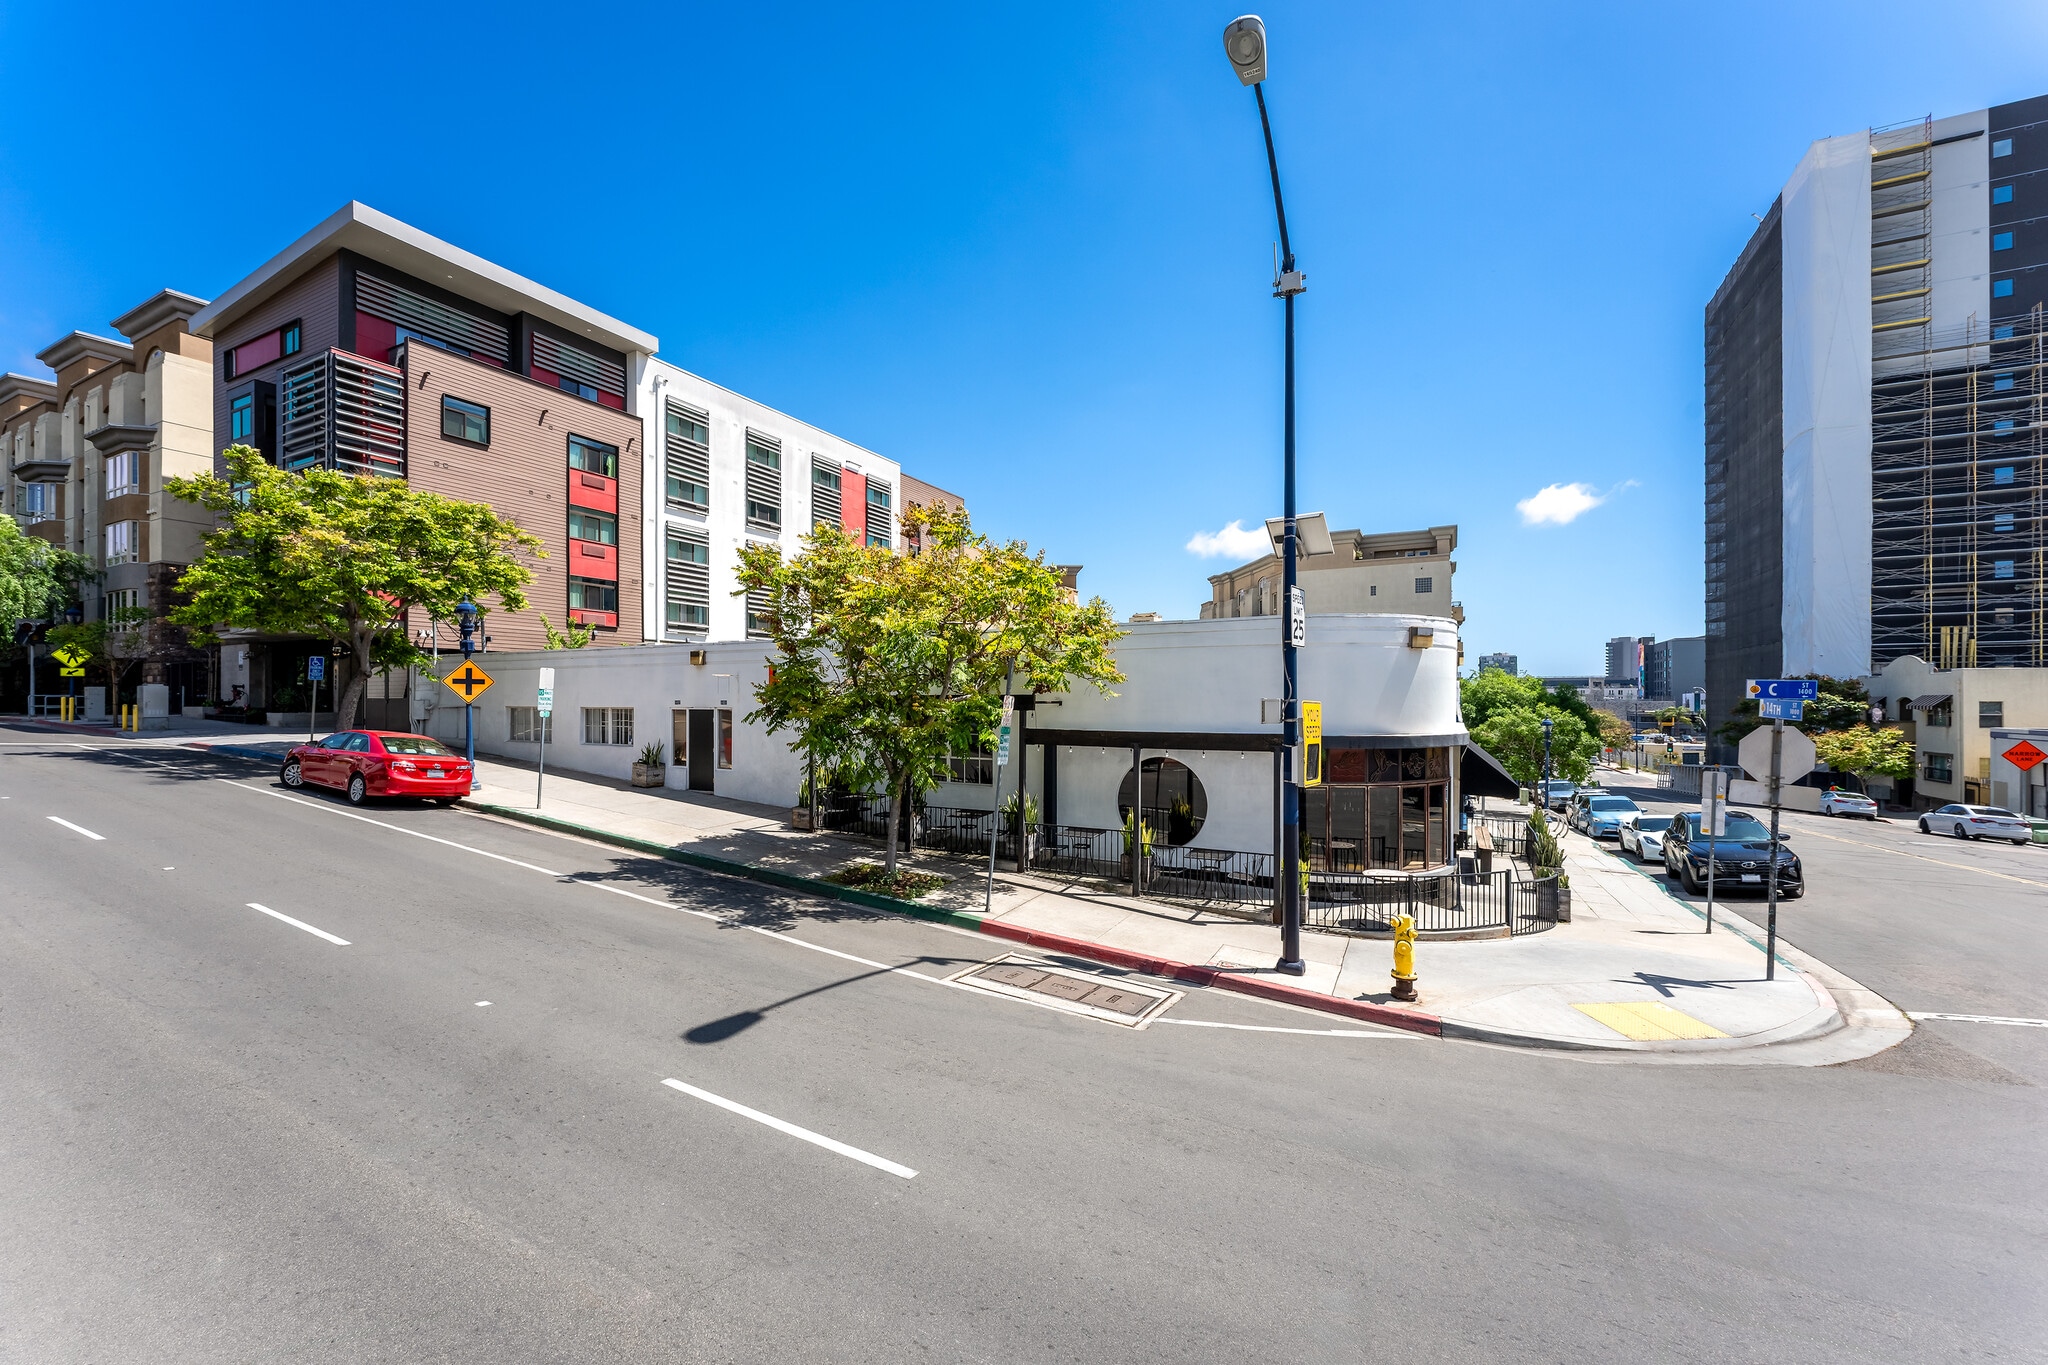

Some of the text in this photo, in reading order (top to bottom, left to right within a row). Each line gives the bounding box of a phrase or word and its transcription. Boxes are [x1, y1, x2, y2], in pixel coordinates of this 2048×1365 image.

[1292, 593, 1304, 605] SPEED
[1293, 605, 1303, 616] LIMIT
[1293, 618, 1304, 640] 25
[1768, 683, 1778, 696] C
[1766, 702, 1781, 715] 14TH
[1306, 709, 1319, 722] YOUR
[1306, 725, 1320, 738] SPEED
